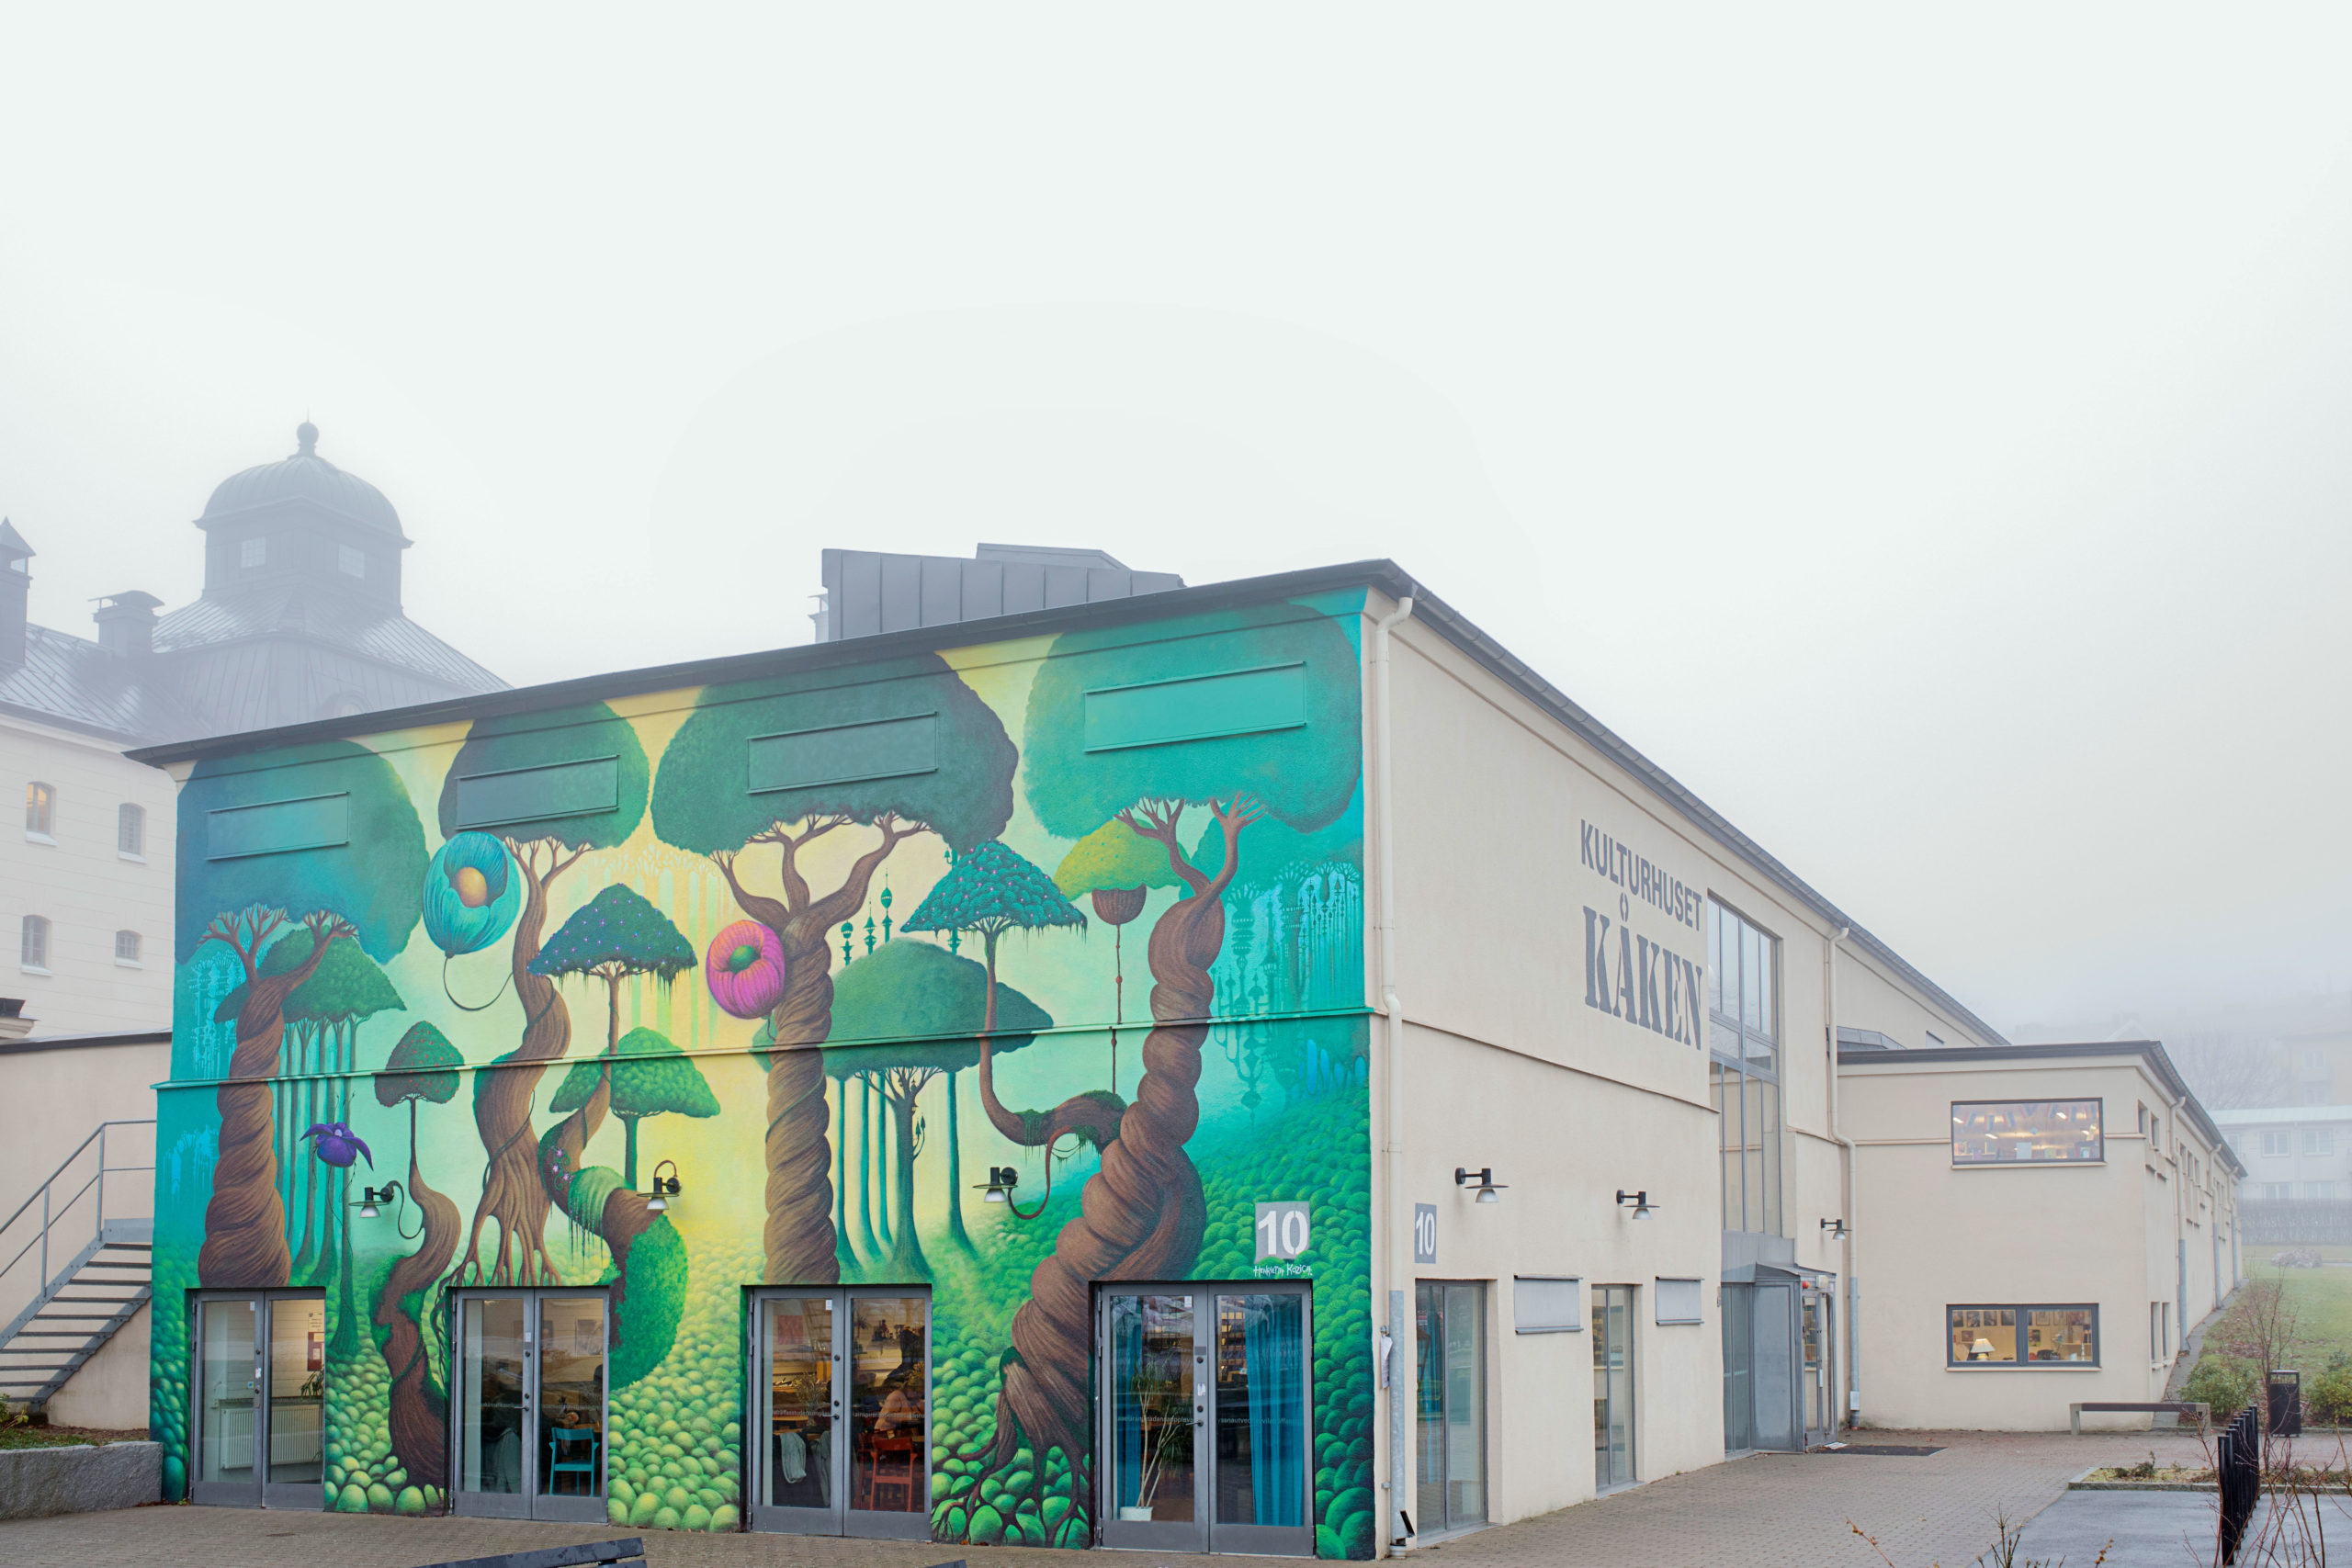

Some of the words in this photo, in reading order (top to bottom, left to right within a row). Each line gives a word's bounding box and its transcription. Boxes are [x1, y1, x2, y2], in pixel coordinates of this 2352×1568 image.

[1581, 818, 1702, 931] KULTURHUSET
[1582, 892, 1702, 1051] KÅKEN
[1258, 1210, 1308, 1255] 10
[1416, 1212, 1435, 1256] 10
